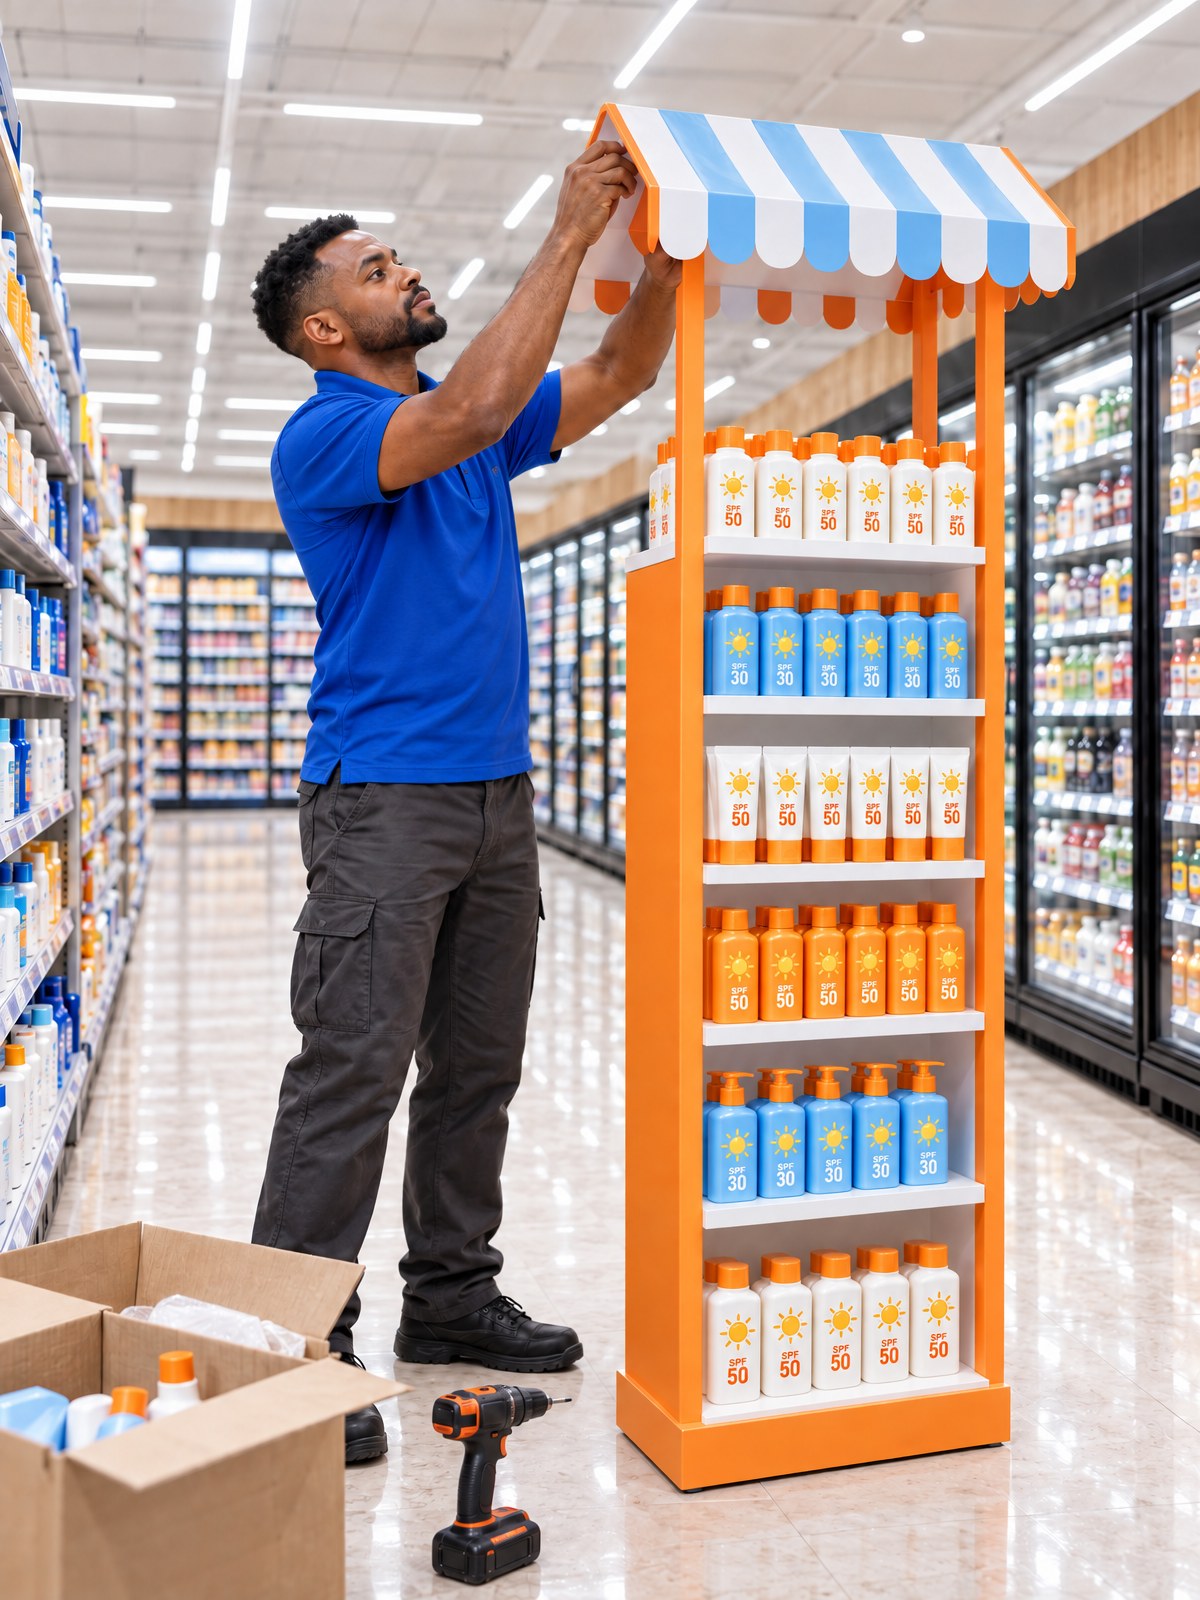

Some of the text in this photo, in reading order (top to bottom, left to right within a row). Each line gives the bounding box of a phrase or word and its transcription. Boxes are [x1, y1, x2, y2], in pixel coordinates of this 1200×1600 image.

[724, 513, 742, 526] 50
[774, 515, 790, 528] 50
[820, 517, 836, 530] 50
[864, 518, 879, 532] 50
[907, 520, 923, 534] 50
[949, 522, 964, 535] 50
[730, 671, 748, 685] 30
[776, 671, 793, 685] 30
[820, 672, 837, 686] 30
[863, 673, 879, 687] 30
[904, 673, 920, 687] 30
[944, 674, 960, 688] 30
[731, 812, 749, 826] 50
[778, 811, 796, 825] 50
[823, 811, 840, 825] 50
[865, 811, 881, 824] 50
[904, 810, 921, 824] 50
[943, 810, 960, 824] 50
[777, 985, 793, 993] SPF
[820, 983, 836, 991] SPF
[861, 981, 877, 989] SPF
[901, 979, 917, 987] SPF
[731, 987, 747, 995] SPF
[819, 991, 837, 1005] 50
[861, 989, 878, 1003] 50
[900, 987, 917, 1001] 50
[940, 985, 957, 999] 50
[729, 995, 748, 1010] 50
[776, 993, 794, 1008] 50
[825, 1159, 841, 1167] SPF
[872, 1155, 888, 1163] SPF
[728, 1167, 746, 1175] SPF
[777, 1163, 794, 1171] SPF
[871, 1163, 889, 1178] 30
[919, 1159, 937, 1174] 30
[776, 1171, 794, 1187] 30
[824, 1167, 842, 1182] 30
[727, 1175, 746, 1191] 30
[881, 1338, 897, 1347] SPF
[930, 1333, 947, 1341] SPF
[781, 1351, 799, 1360] SPF
[832, 1345, 849, 1354] SPF
[879, 1347, 898, 1364] 50
[929, 1341, 948, 1358] 50
[729, 1358, 746, 1367] SPF
[779, 1360, 800, 1377] 50
[830, 1354, 850, 1371] 50
[727, 1367, 748, 1385] 50
